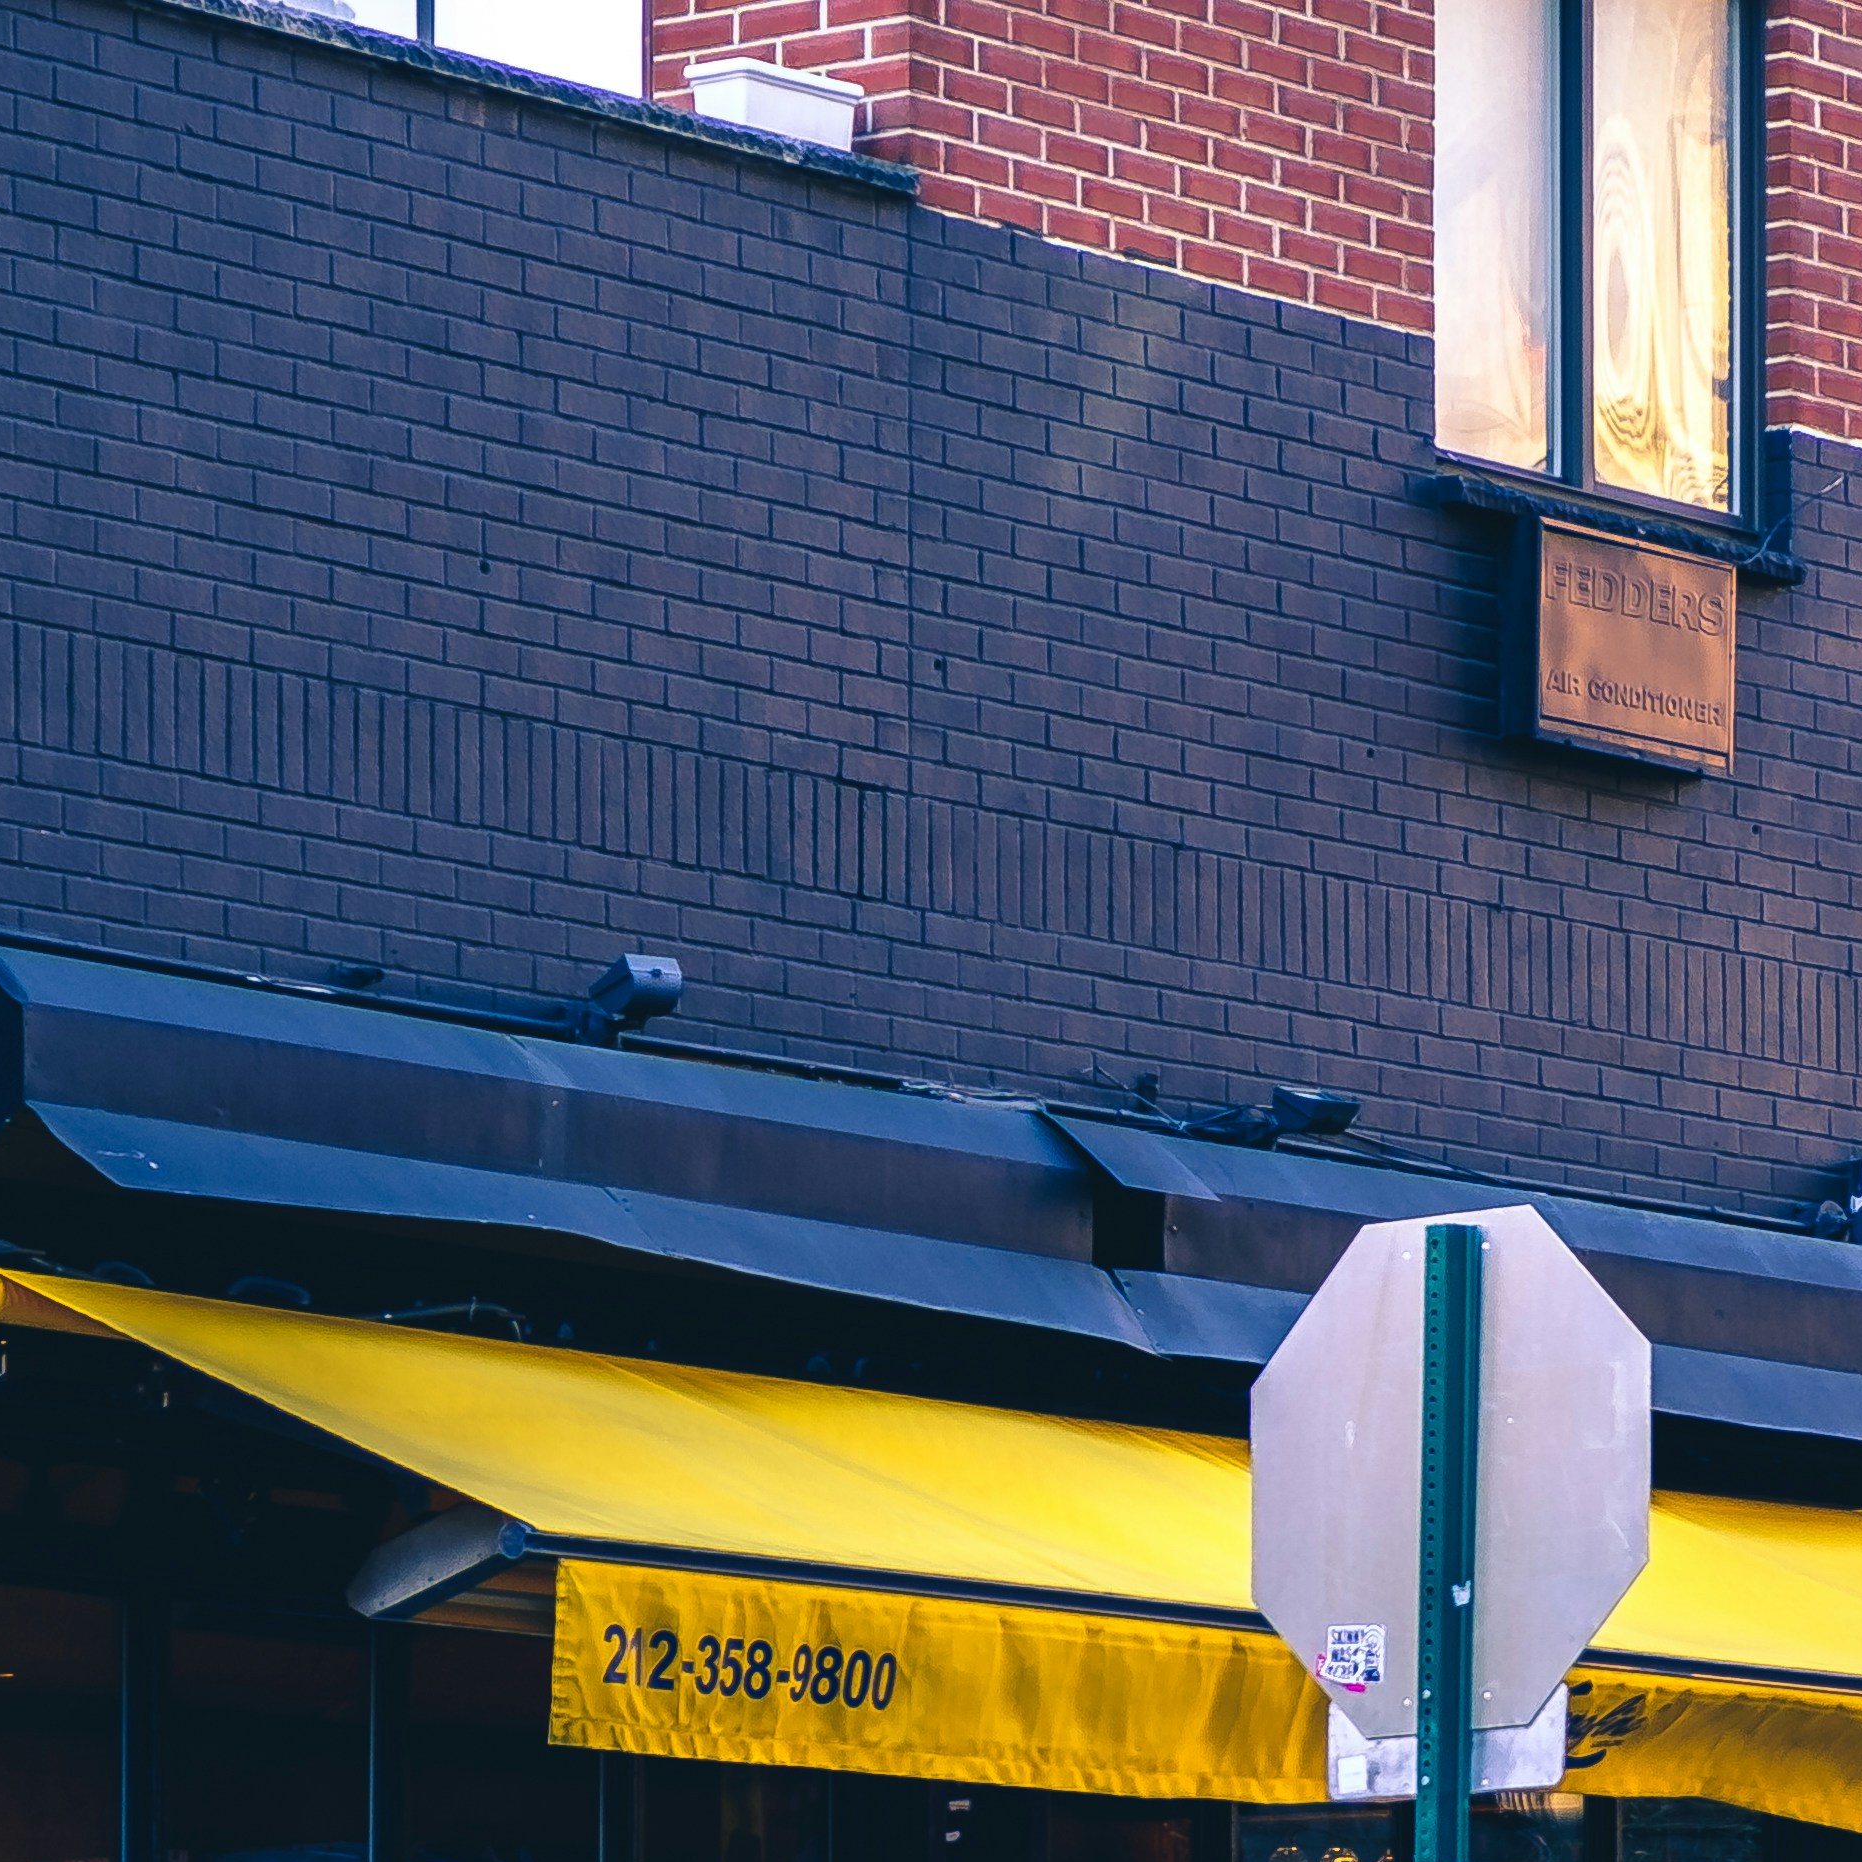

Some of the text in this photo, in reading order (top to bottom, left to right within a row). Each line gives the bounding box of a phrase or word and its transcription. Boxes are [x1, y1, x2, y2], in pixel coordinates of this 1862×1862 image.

[1544, 556, 1726, 637] FEDDERS
[1545, 668, 1726, 727] AIR CONDITIONER
[602, 1624, 898, 1711] 212-358-9800
